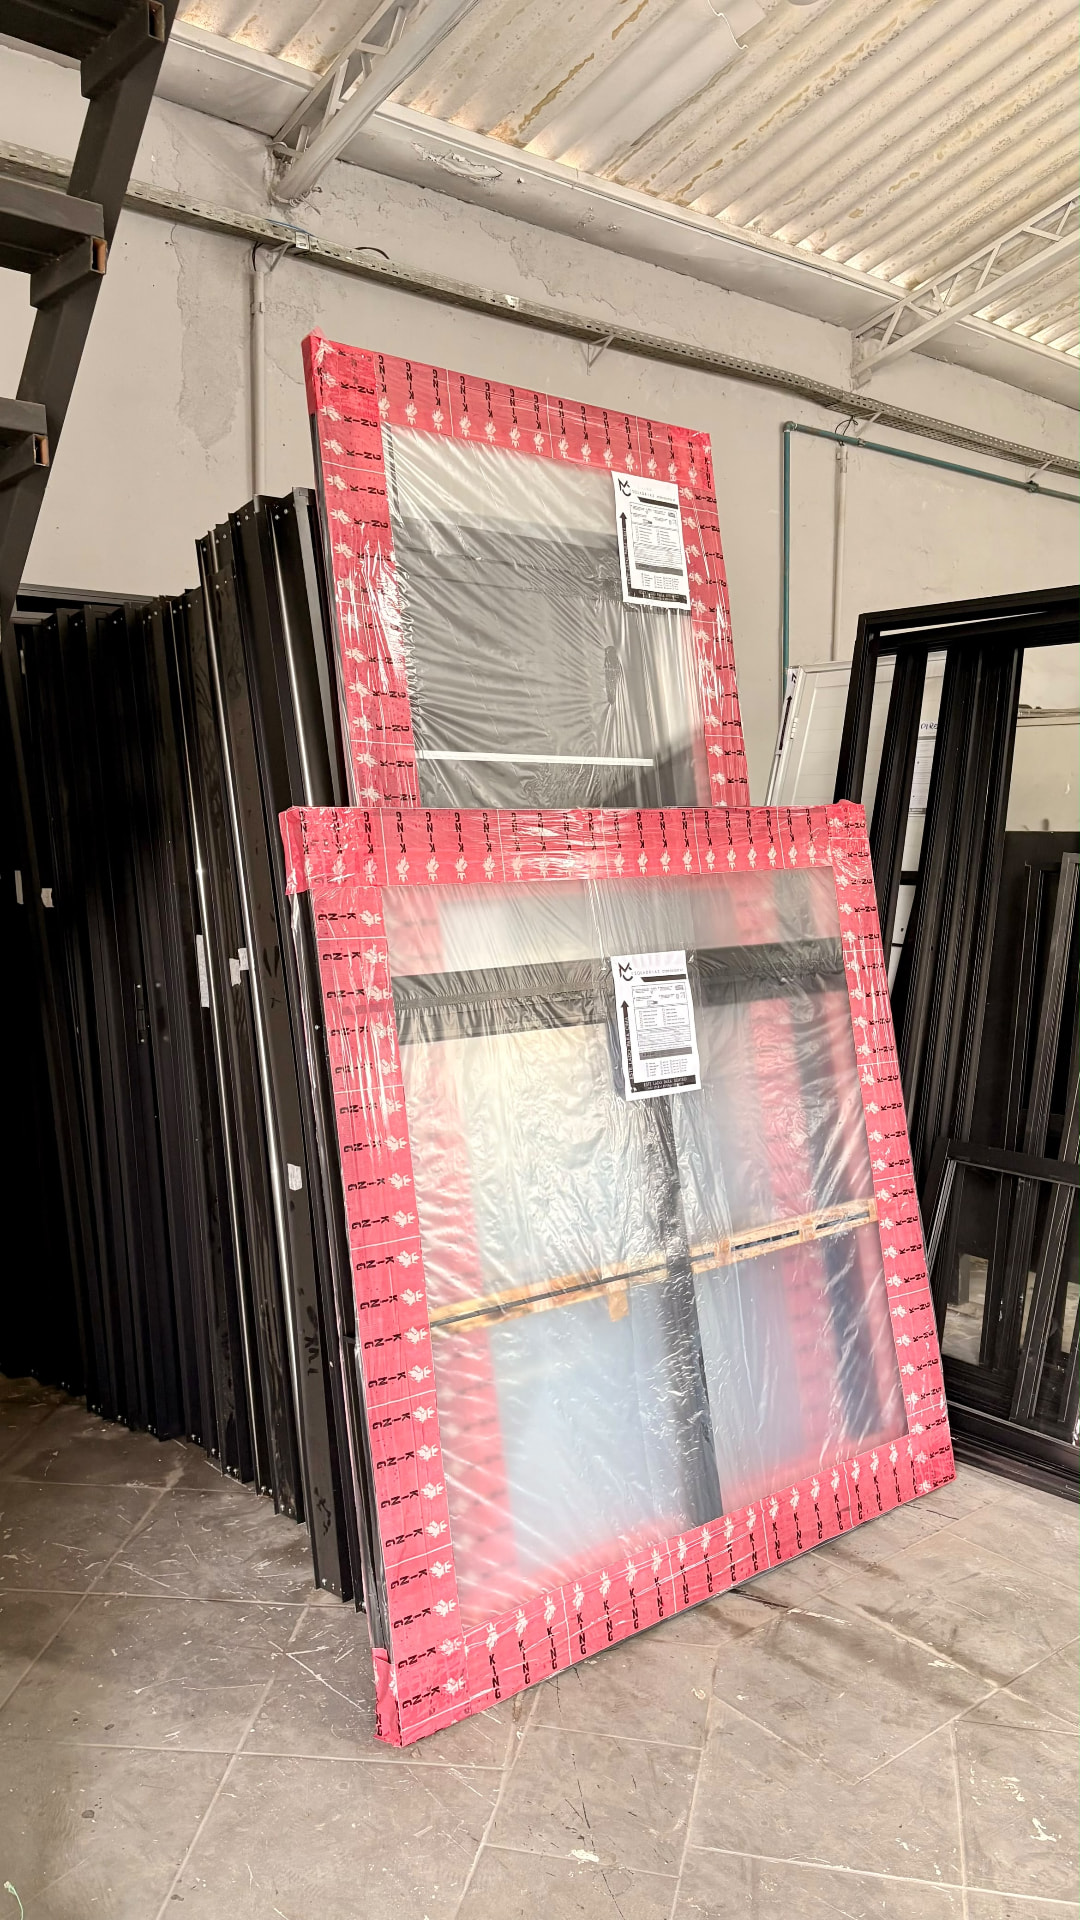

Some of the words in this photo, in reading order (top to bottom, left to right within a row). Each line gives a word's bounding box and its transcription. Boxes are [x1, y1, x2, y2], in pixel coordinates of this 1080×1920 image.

[379, 354, 387, 393] KING
[406, 361, 414, 399] KING
[341, 381, 374, 395] KING
[460, 375, 468, 411] KING
[485, 381, 493, 417] KING
[343, 415, 378, 427] KING
[346, 449, 382, 460] KING
[349, 485, 386, 495] KING
[353, 518, 389, 528] KING
[372, 690, 406, 698] KING
[375, 723, 410, 731] KING
[383, 793, 417, 801] KING
[299, 810, 309, 854] KING
[332, 811, 342, 853] KING
[364, 811, 373, 853] KING
[396, 811, 406, 853] KING
[426, 811, 435, 852] KING
[455, 812, 463, 852] KING
[483, 812, 491, 852] KING
[659, 811, 667, 847] KING
[705, 810, 713, 846] KING
[726, 809, 735, 845] KING
[317, 912, 357, 920] KING
[854, 905, 877, 913] KING
[322, 951, 361, 960] KING
[326, 988, 365, 998] KING
[876, 1075, 899, 1083] KING
[880, 1102, 903, 1110] KING
[884, 1130, 906, 1138] KING
[343, 1140, 382, 1152] KING
[888, 1158, 910, 1167] KING
[347, 1178, 386, 1191] KING
[892, 1188, 914, 1197] KING
[351, 1215, 390, 1229] KING
[895, 1215, 919, 1225] KING
[899, 1243, 922, 1254] KING
[356, 1256, 395, 1270] KING
[903, 1272, 926, 1283] KING
[359, 1294, 398, 1309] KING
[908, 1302, 931, 1313] KING
[364, 1333, 402, 1349] KING
[912, 1330, 934, 1342] KING
[917, 1358, 939, 1370] KING
[367, 1371, 407, 1388] KING
[920, 1387, 942, 1399] KING
[372, 1412, 411, 1429] KING
[925, 1416, 947, 1429] KING
[376, 1451, 415, 1469] KING
[929, 1445, 950, 1458] KING
[932, 1473, 955, 1487] KING
[380, 1489, 419, 1508] KING
[874, 1476, 882, 1511] KING
[835, 1493, 843, 1530] KING
[385, 1528, 423, 1547] KING
[794, 1512, 802, 1549] KING
[773, 1521, 781, 1559] KING
[750, 1532, 758, 1570] KING
[727, 1543, 736, 1581] KING
[390, 1568, 428, 1589] KING
[704, 1553, 712, 1592] KING
[681, 1564, 689, 1603] KING
[655, 1576, 663, 1617] KING
[393, 1607, 432, 1628] KING
[630, 1588, 638, 1629] KING
[604, 1600, 613, 1641] KING
[577, 1612, 586, 1654] KING
[547, 1626, 557, 1669] KING
[398, 1646, 437, 1669] KING
[519, 1639, 530, 1684] KING
[489, 1653, 500, 1699] KING
[402, 1685, 441, 1710] KING
